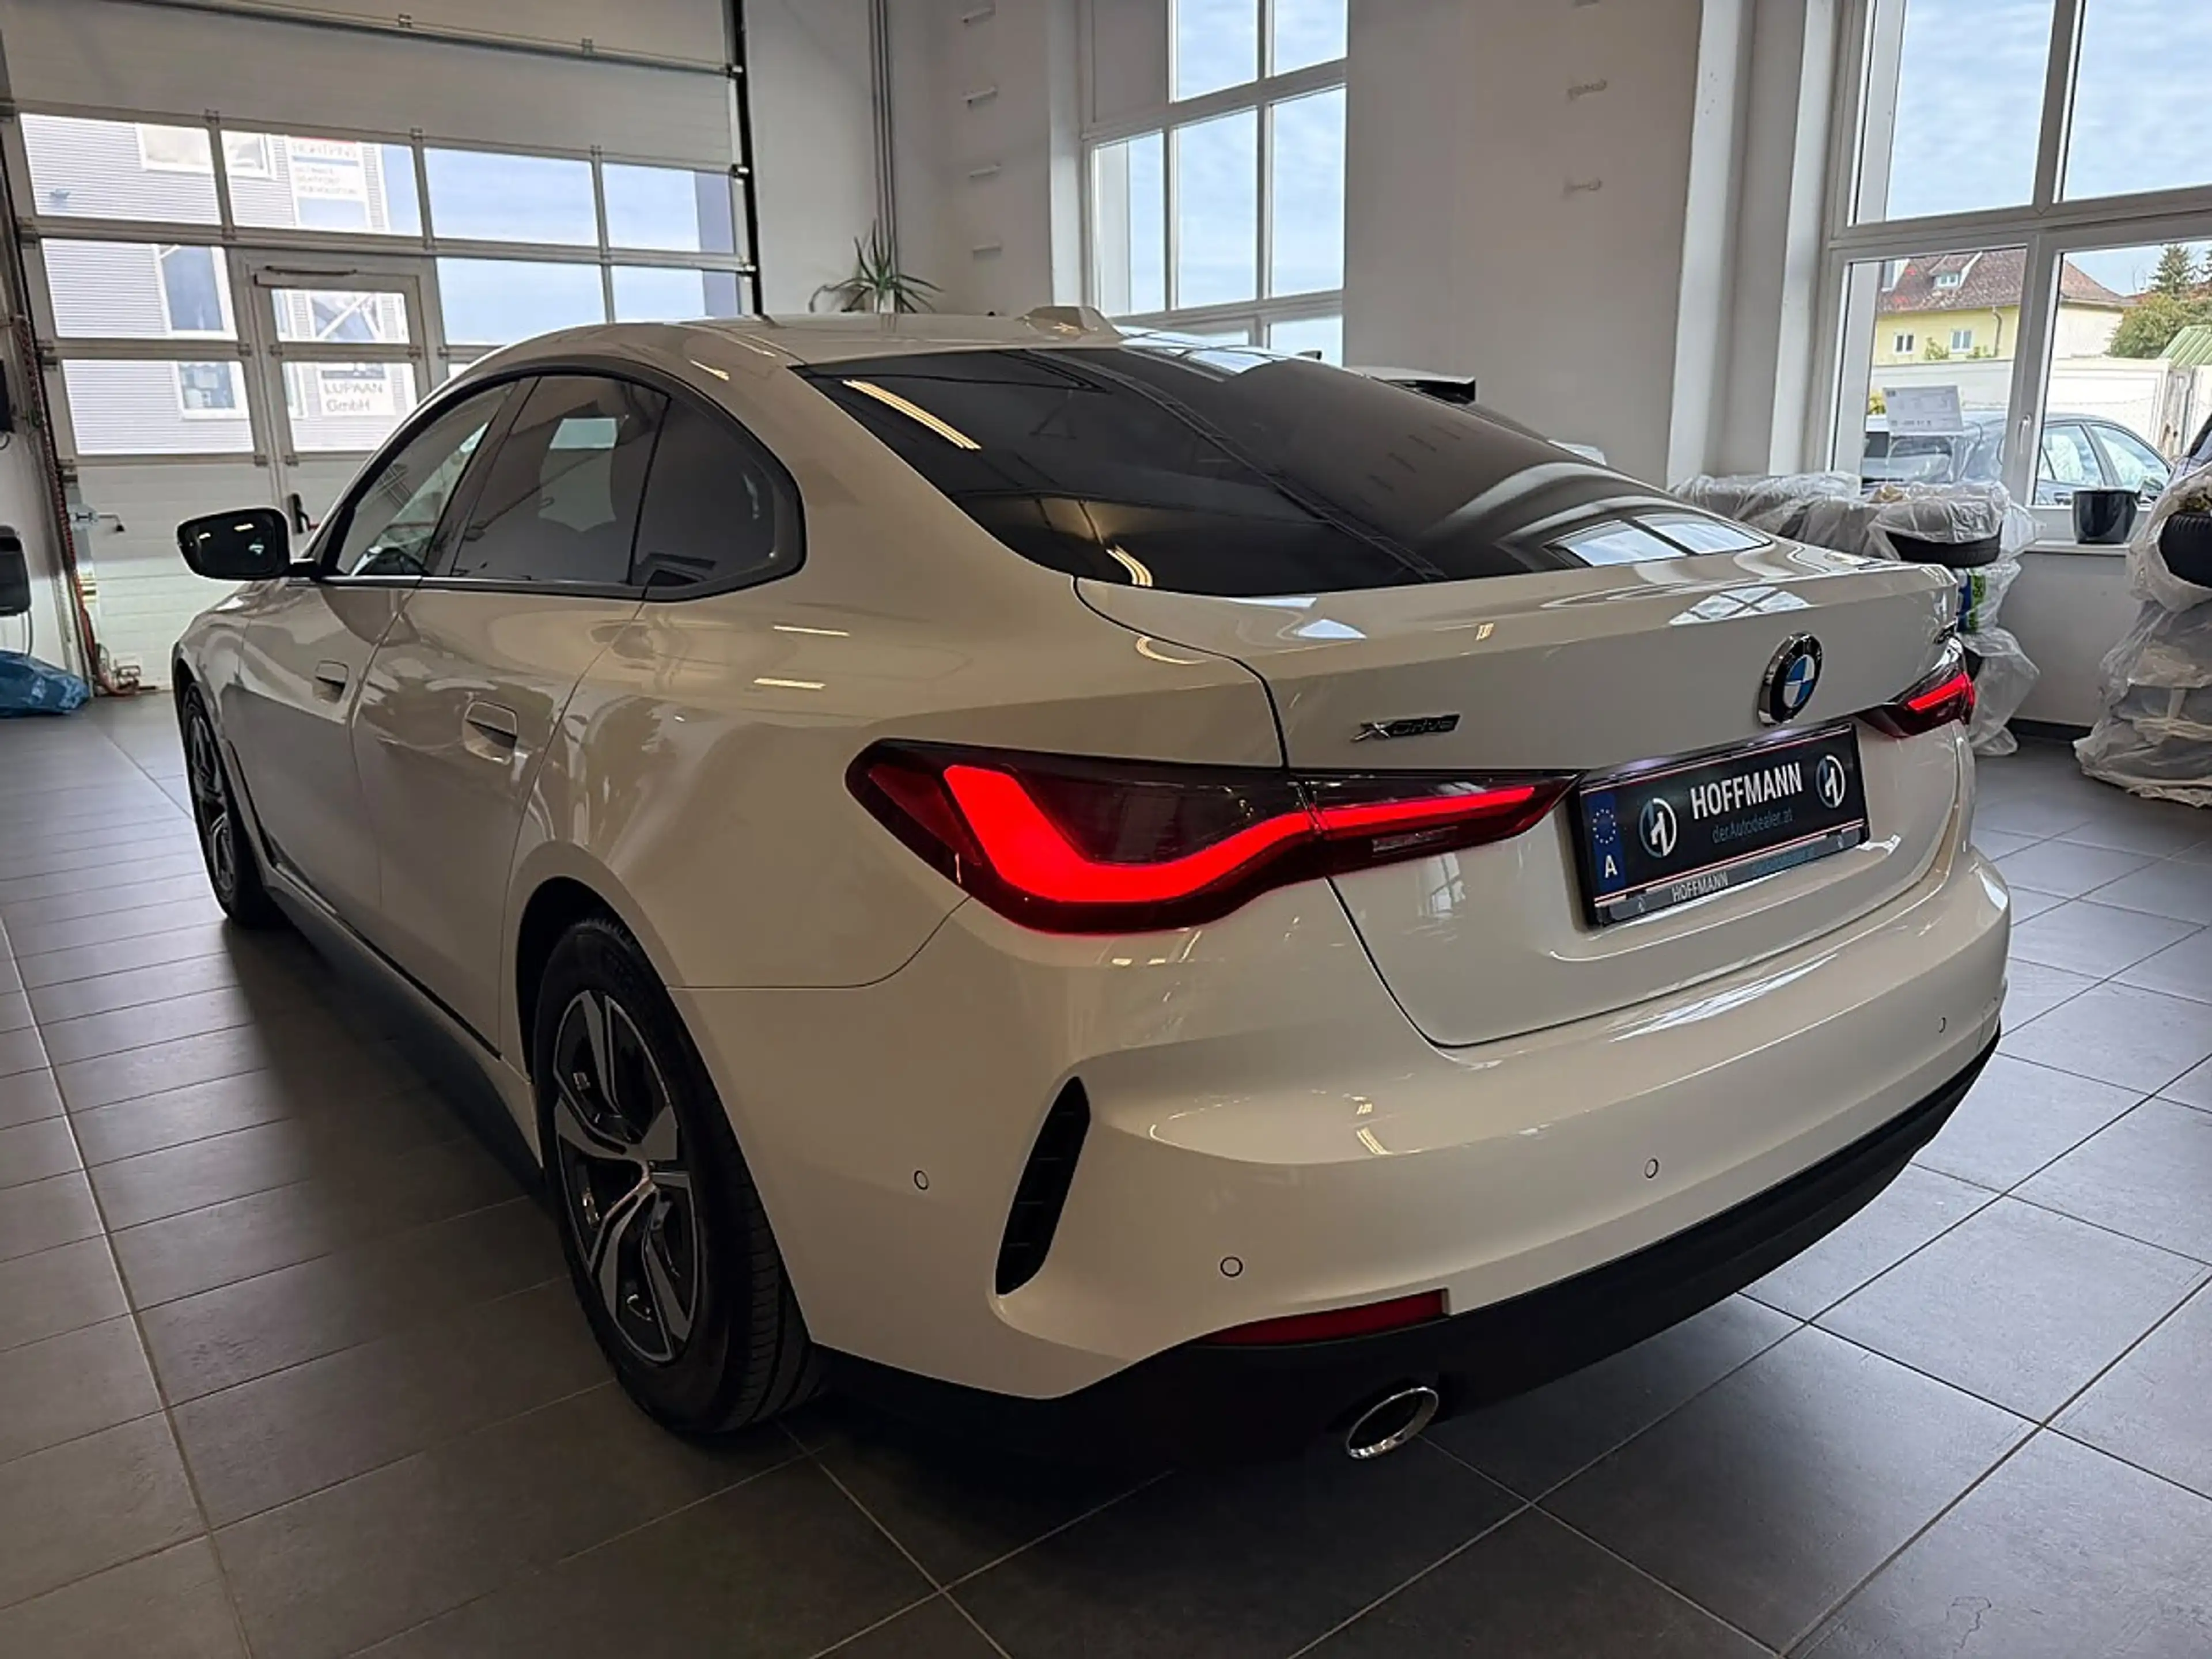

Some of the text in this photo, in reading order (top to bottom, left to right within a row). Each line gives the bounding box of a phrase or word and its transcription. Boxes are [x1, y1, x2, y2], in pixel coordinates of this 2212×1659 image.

[1690, 762, 1803, 820] HOFFMANN
[1604, 855, 1618, 878] A
[1672, 871, 1729, 903] HOFFMANN
